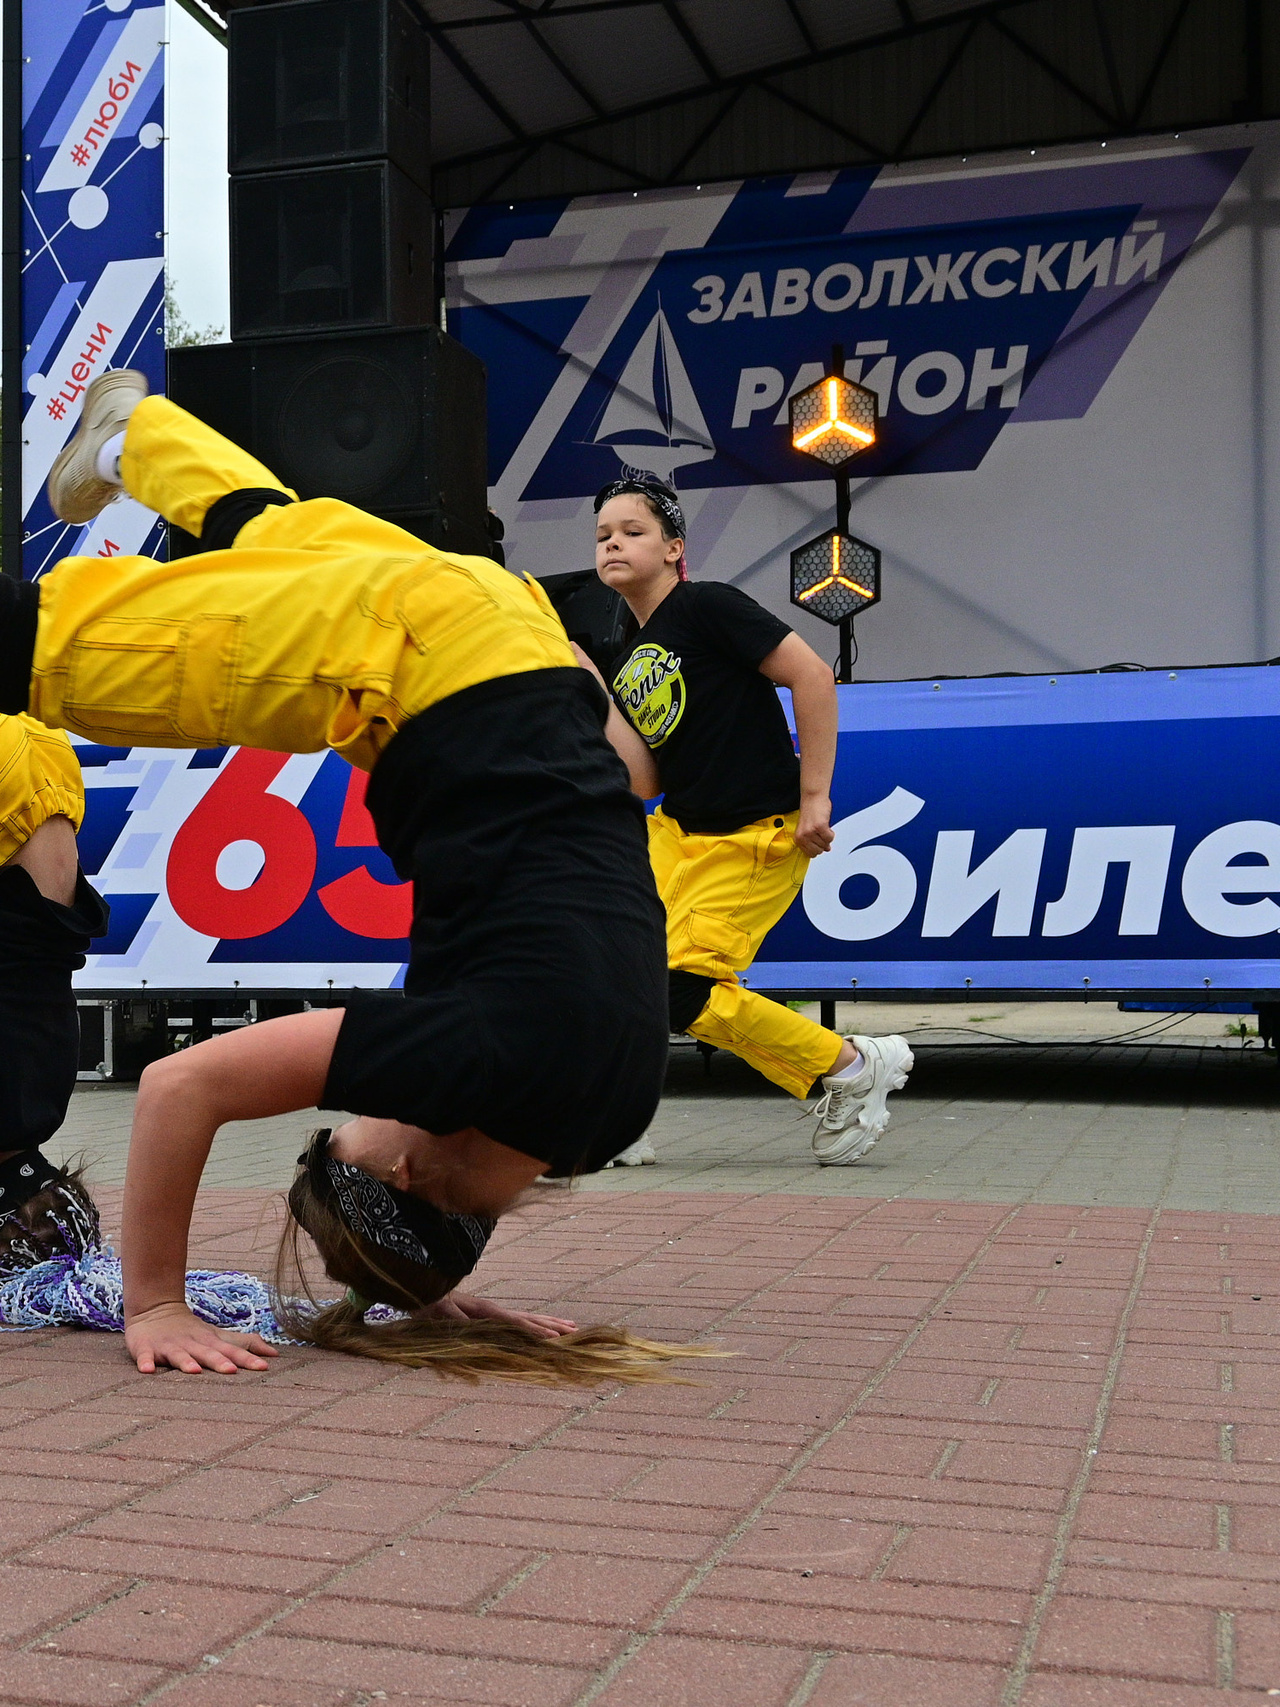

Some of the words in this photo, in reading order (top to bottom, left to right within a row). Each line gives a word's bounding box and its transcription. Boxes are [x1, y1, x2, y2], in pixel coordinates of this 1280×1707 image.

[71, 59, 142, 168] #люби
[687, 221, 1165, 325] ЗАВОЛЖСКИЙ
[47, 321, 113, 421] #цени
[732, 340, 1029, 429] РАЙОН
[618, 651, 682, 711] Fenix
[638, 702, 652, 727] DANCE
[647, 703, 666, 730] STUDIO
